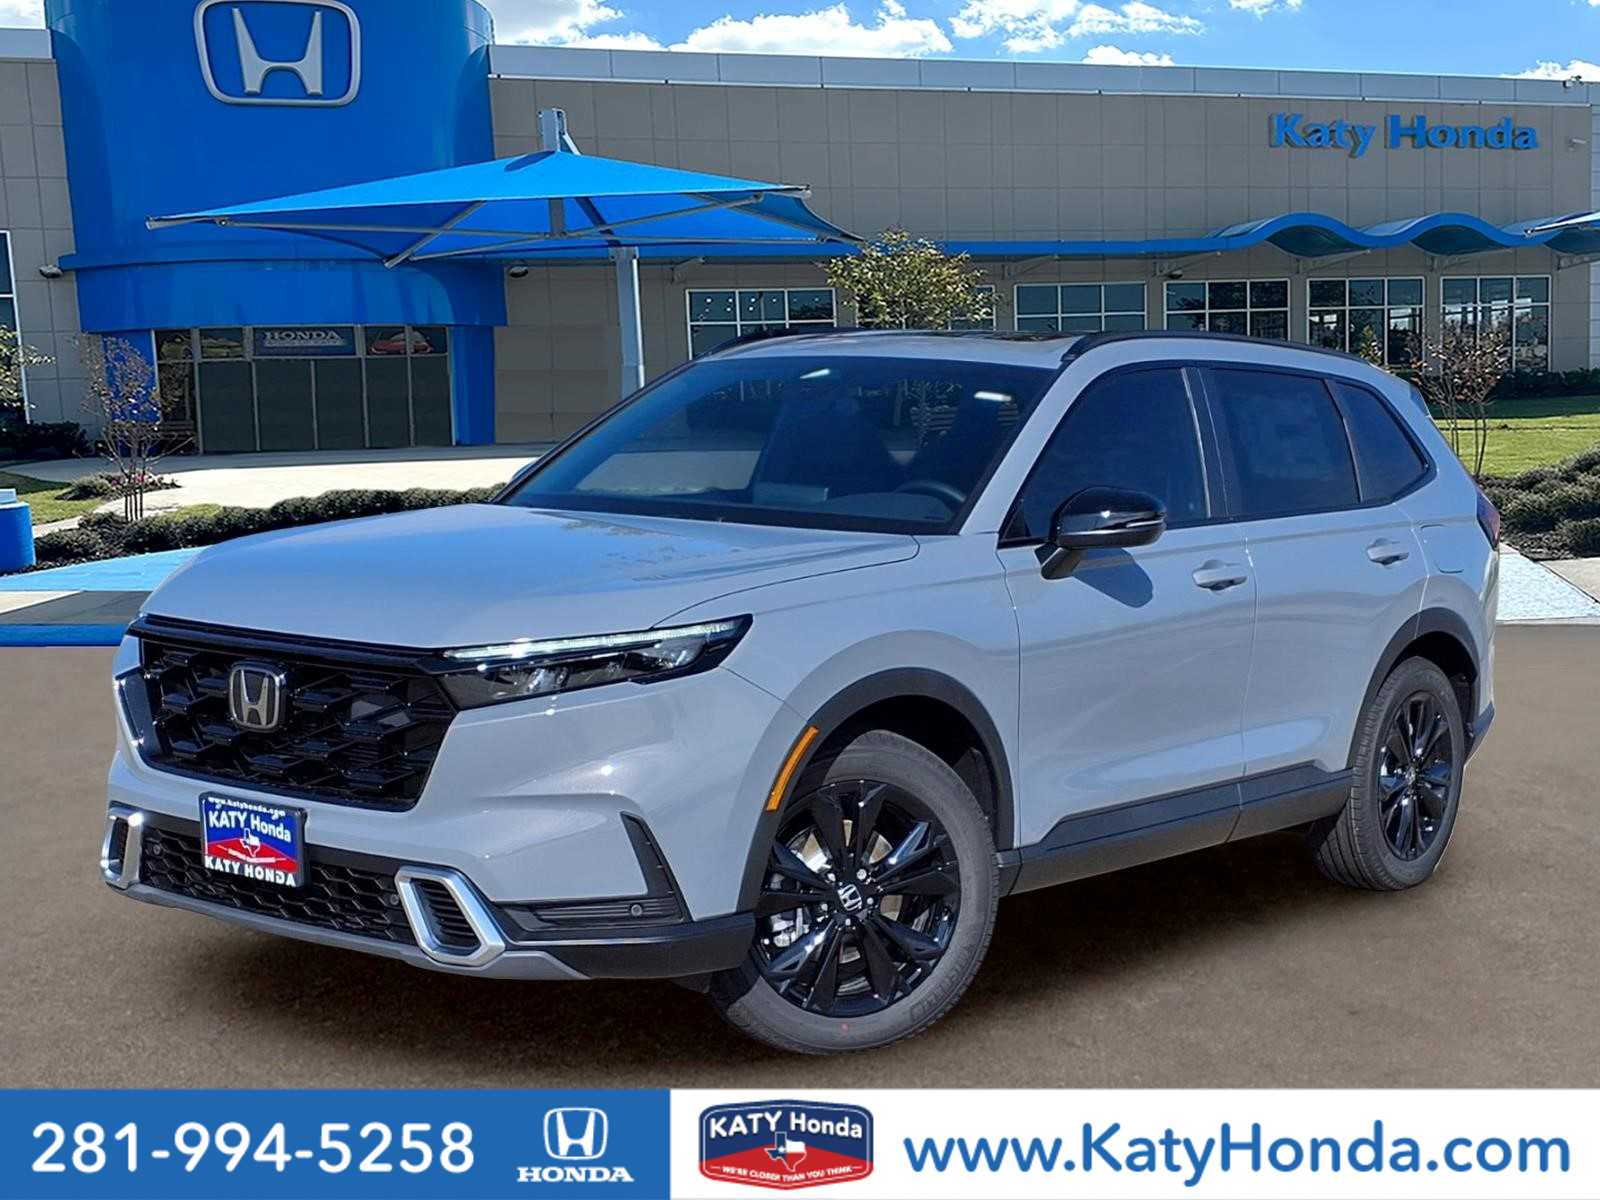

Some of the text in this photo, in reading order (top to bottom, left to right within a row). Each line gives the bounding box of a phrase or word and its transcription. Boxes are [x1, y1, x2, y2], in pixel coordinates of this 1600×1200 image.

[1269, 112, 1538, 158] Katy Honda
[264, 331, 343, 340] HONDA
[208, 810, 292, 842] KATY Honda
[204, 855, 241, 875] KATY
[244, 863, 297, 887] HONDA
